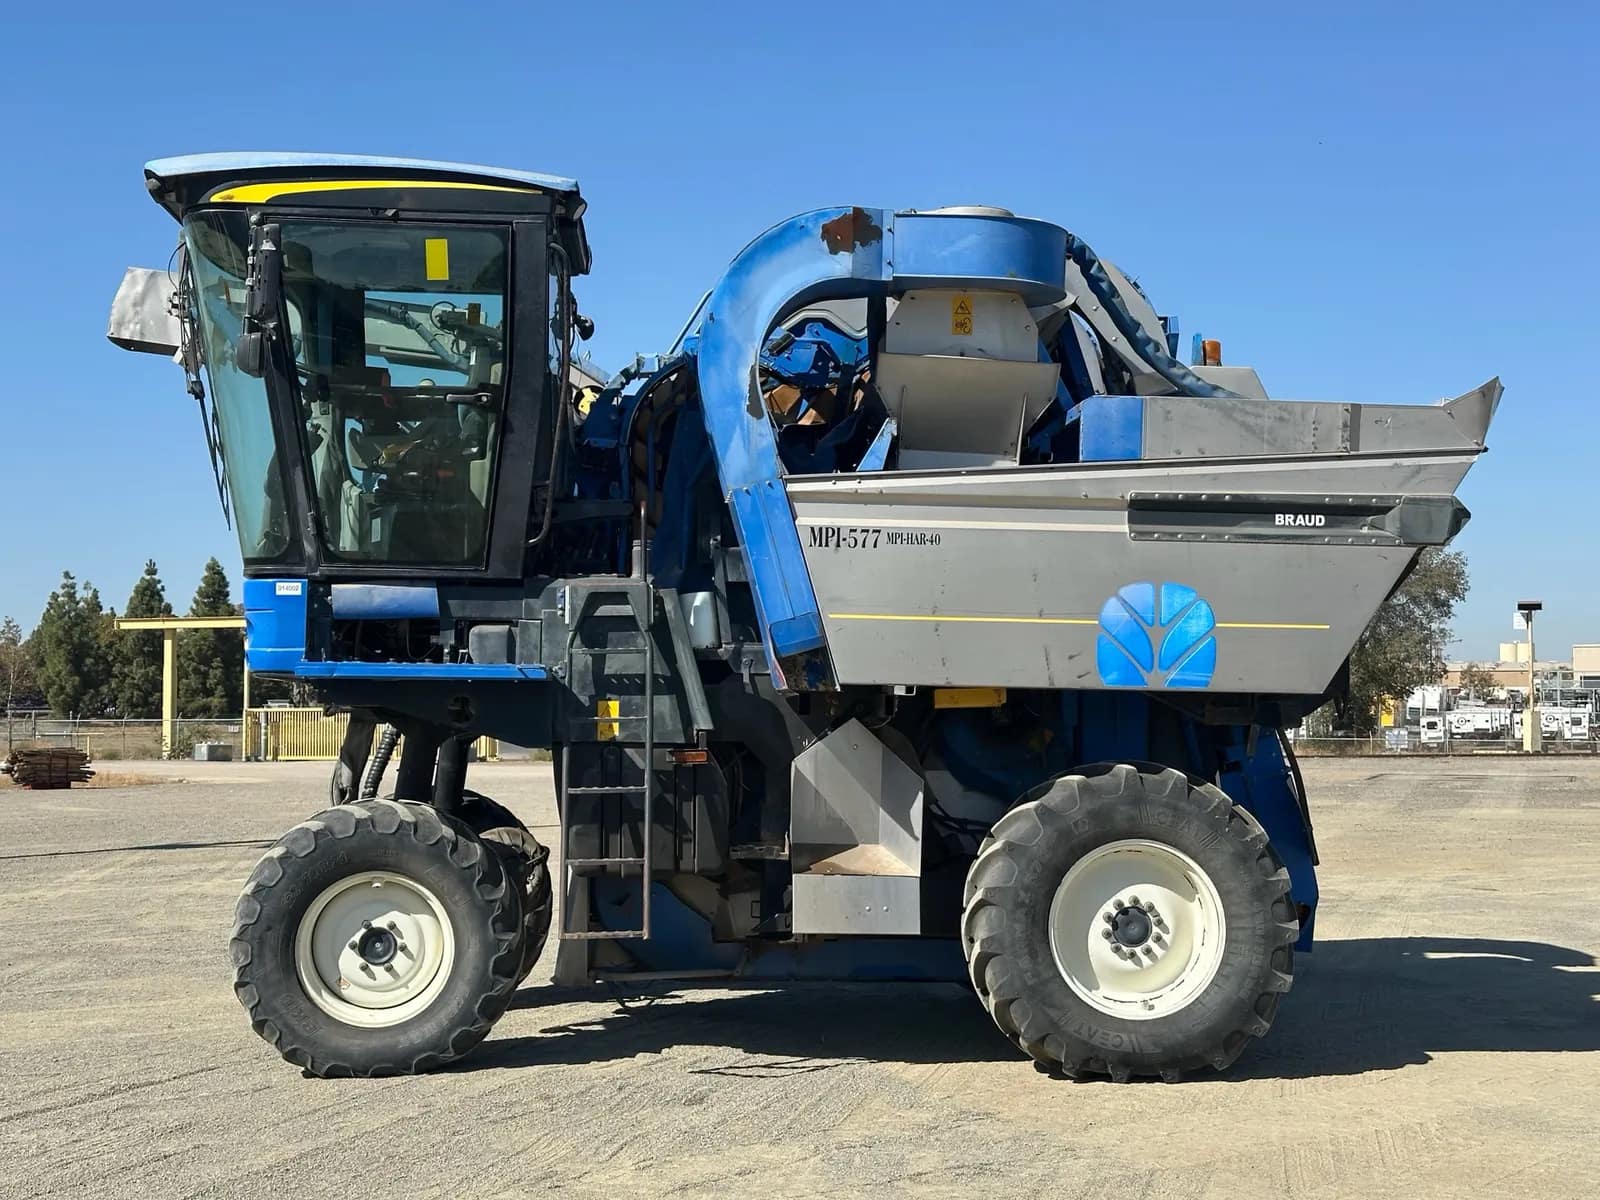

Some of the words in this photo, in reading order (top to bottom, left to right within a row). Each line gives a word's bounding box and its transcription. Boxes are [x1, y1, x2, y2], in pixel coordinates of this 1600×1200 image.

[1275, 513, 1325, 526] BRAUD
[808, 526, 882, 549] MPI-577
[886, 532, 941, 546] MPI-HAR-40
